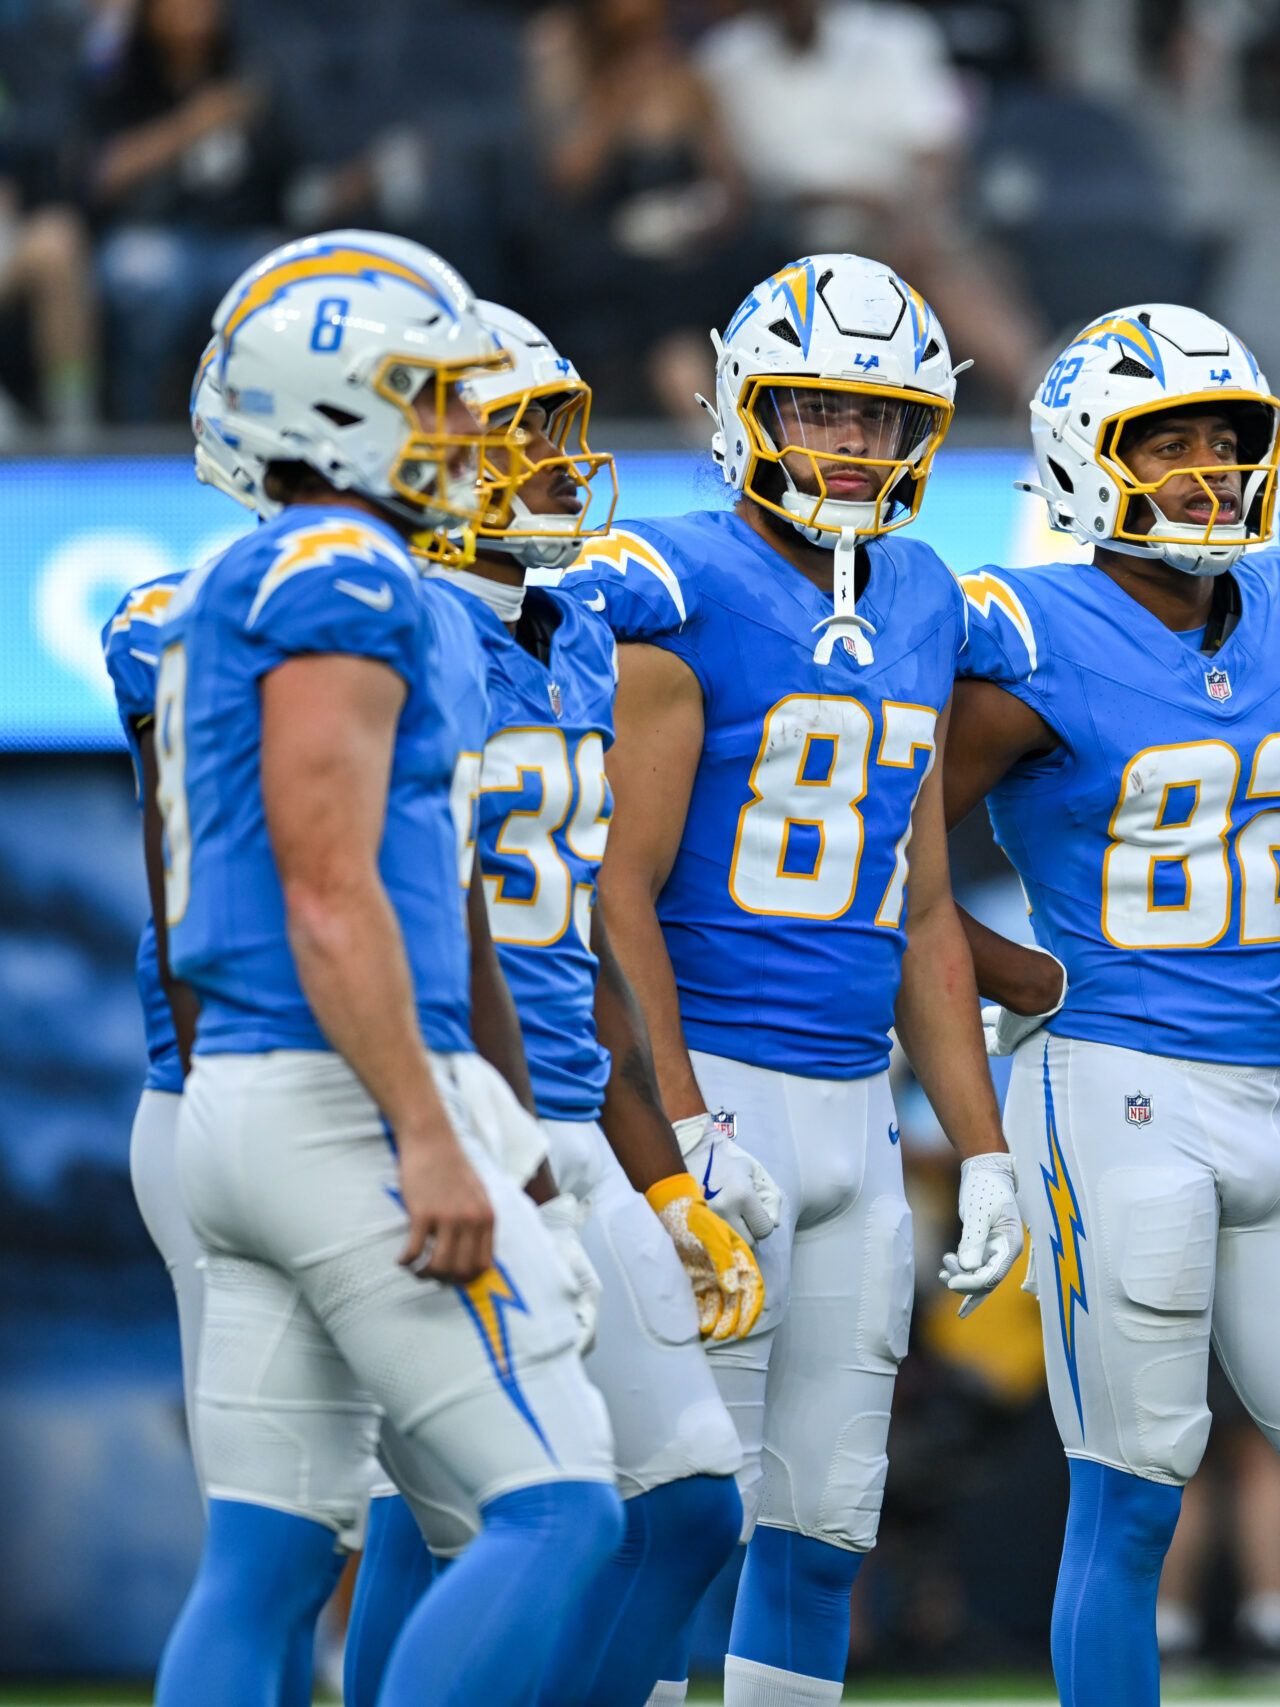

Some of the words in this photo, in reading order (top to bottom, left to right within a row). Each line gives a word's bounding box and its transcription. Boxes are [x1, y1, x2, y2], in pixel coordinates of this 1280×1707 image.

[309, 298, 349, 353] 8
[854, 353, 880, 372] LA
[1209, 369, 1232, 386] LA
[1041, 356, 1085, 408] 82
[728, 692, 940, 929] 87
[1130, 1107, 1150, 1121] NFL
